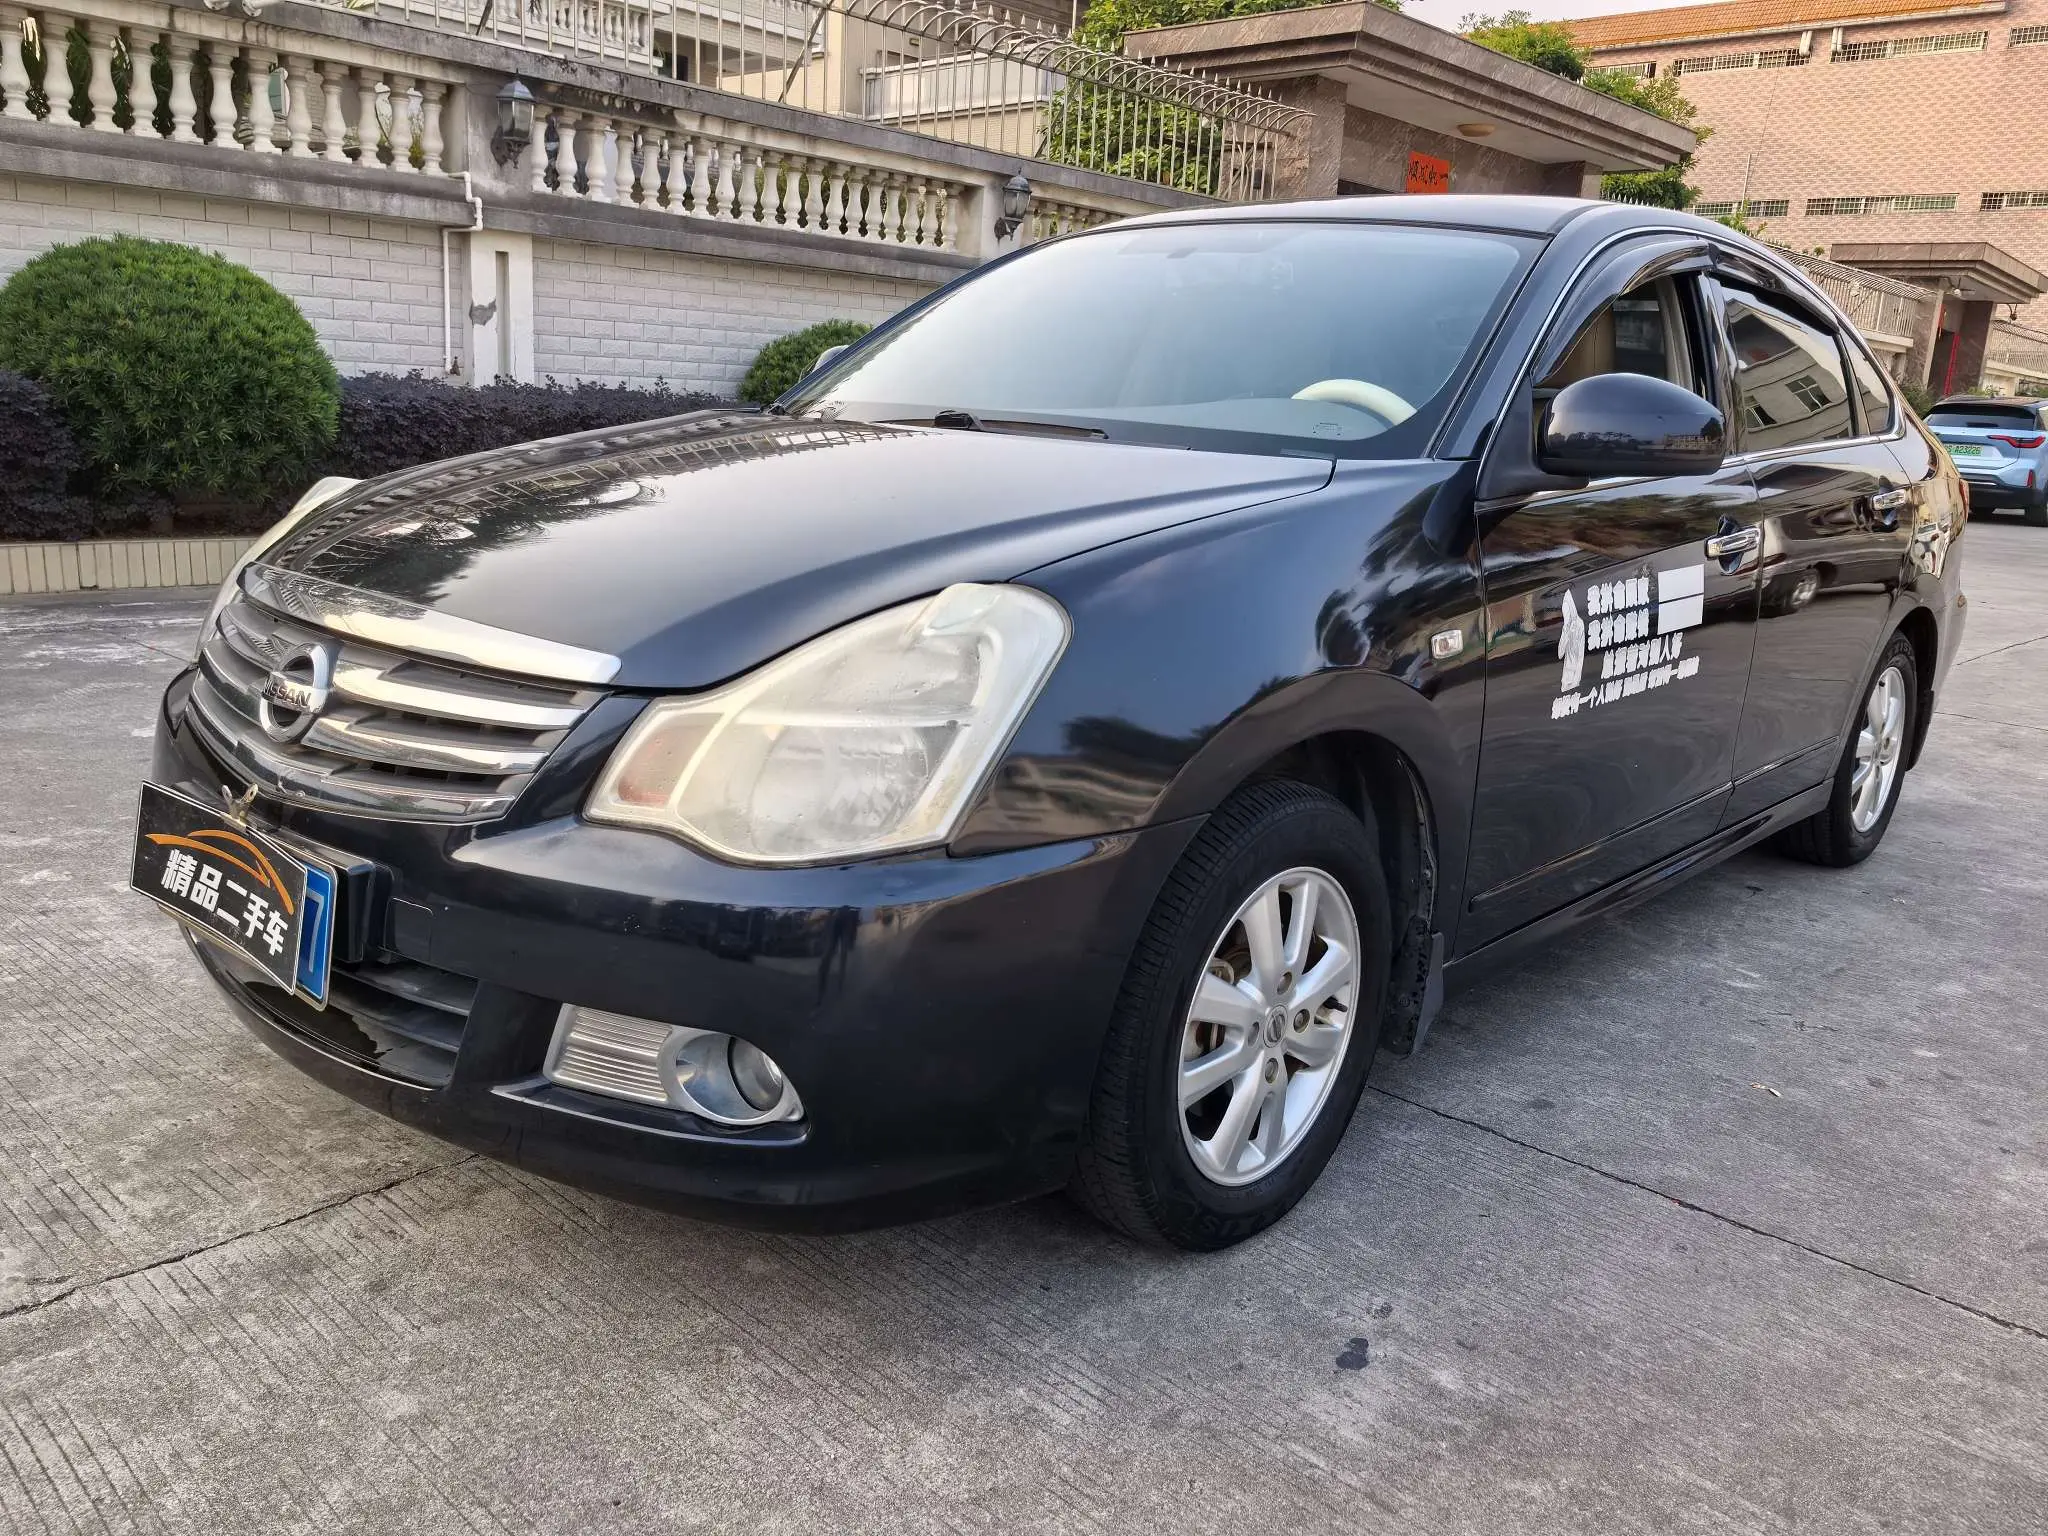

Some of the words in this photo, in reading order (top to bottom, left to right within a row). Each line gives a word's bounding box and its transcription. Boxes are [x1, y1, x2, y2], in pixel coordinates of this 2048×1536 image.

[160, 848, 288, 956] 精品二手车
